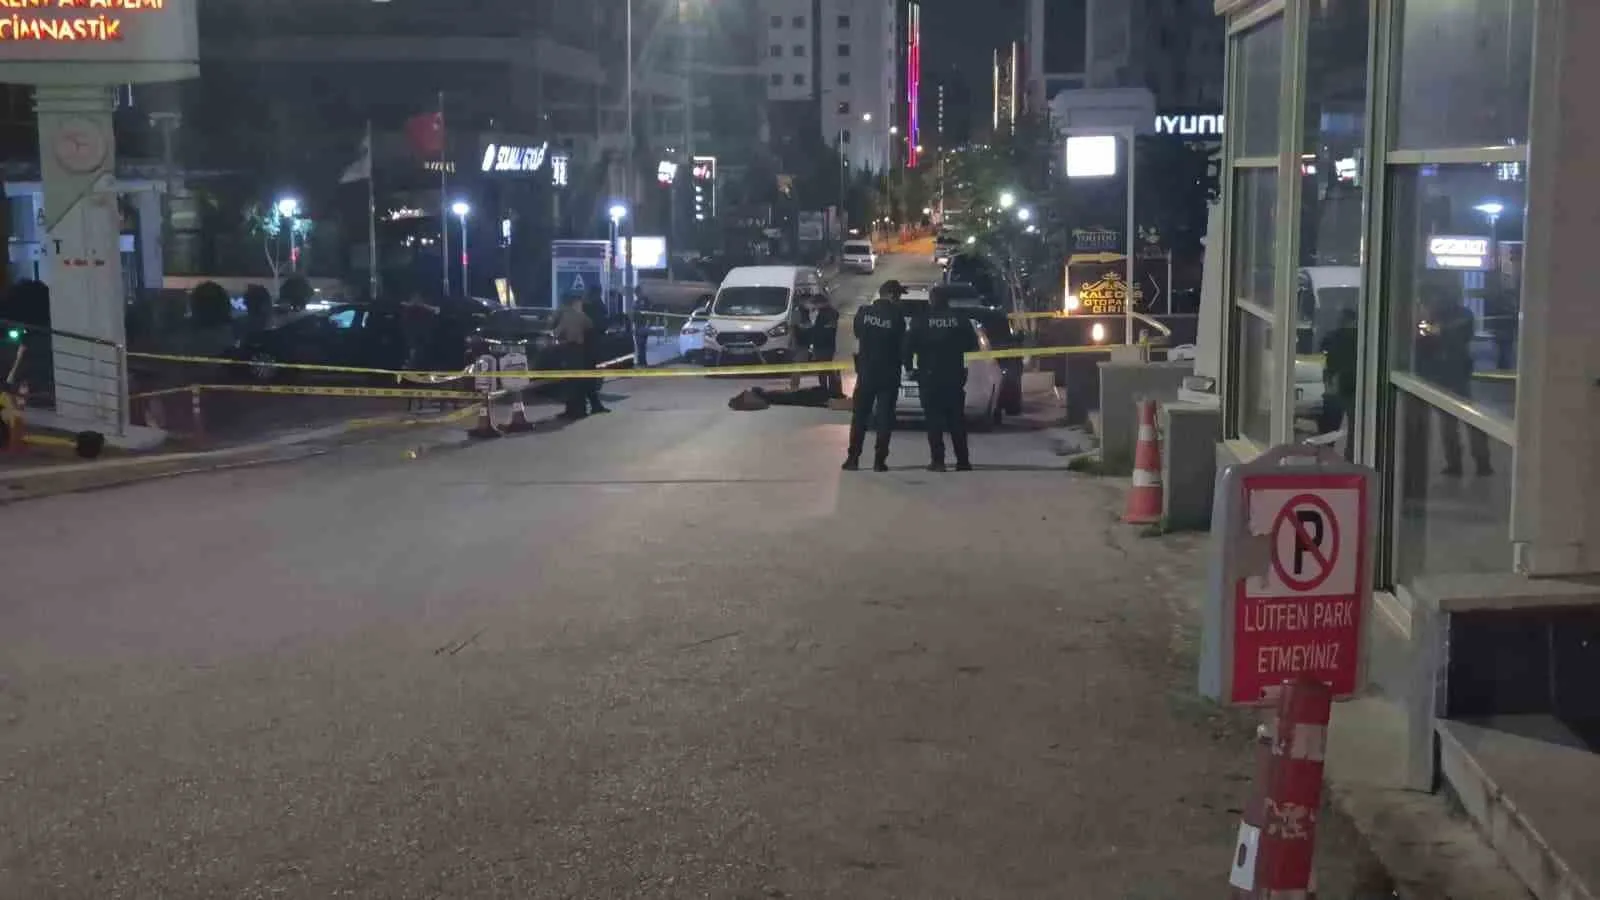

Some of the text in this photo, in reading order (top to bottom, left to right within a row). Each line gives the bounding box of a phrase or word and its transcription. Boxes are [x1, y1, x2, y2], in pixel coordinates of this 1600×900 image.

[1244, 600, 1353, 632] LÜTFEN PARK
[1257, 640, 1340, 673] ETMEYİNİZ
